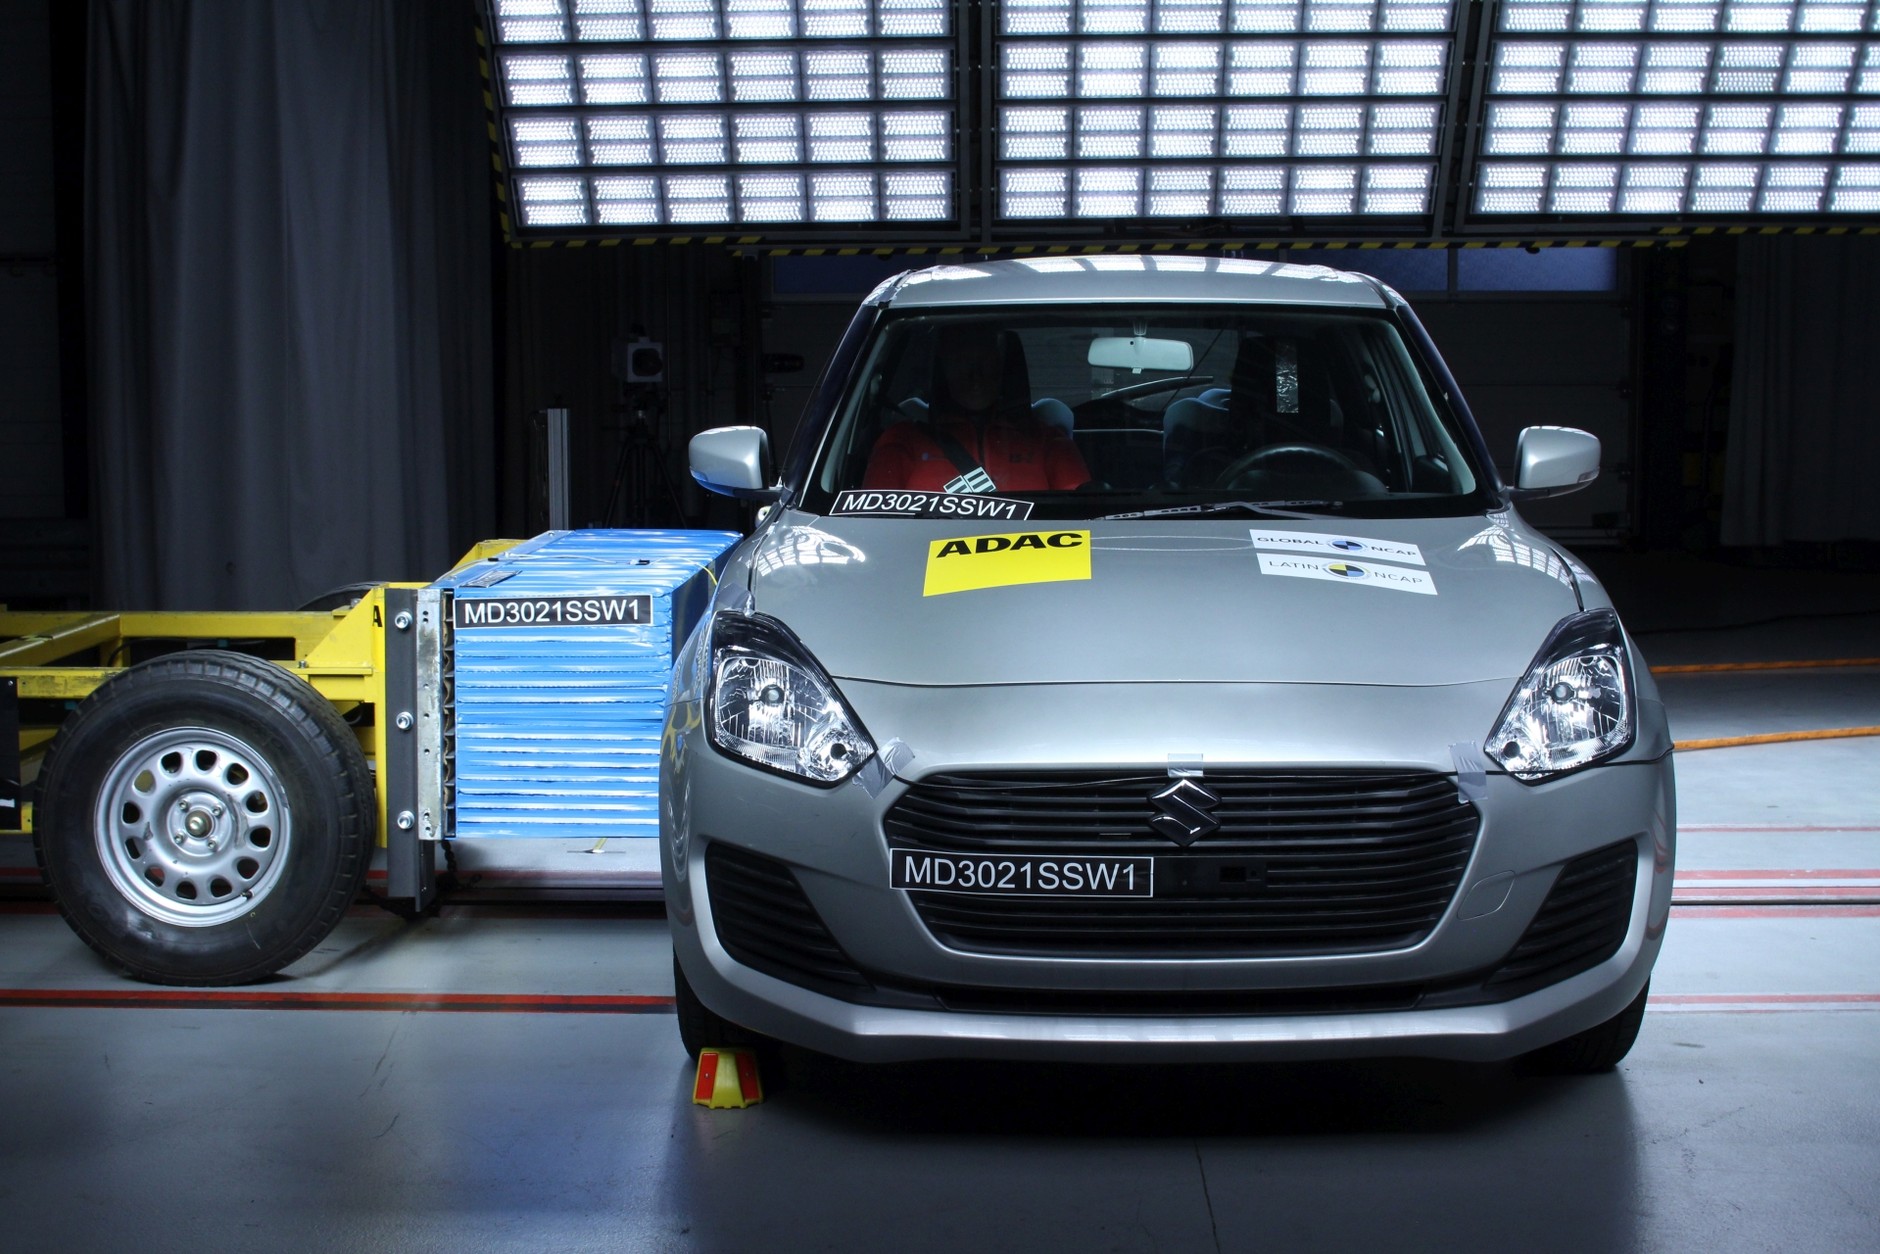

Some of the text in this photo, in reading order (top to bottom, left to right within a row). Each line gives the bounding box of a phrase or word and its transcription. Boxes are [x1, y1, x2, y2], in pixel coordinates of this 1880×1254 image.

[842, 493, 1017, 519] MD3021SSW1
[936, 533, 1083, 558] ADAC
[1257, 537, 1417, 556] GLOBAL NCAP
[1269, 561, 1423, 584] LATIN NCAP
[372, 605, 383, 628] A
[464, 599, 639, 625] MD3021SSW1
[905, 856, 1136, 891] MD3021SSW1
